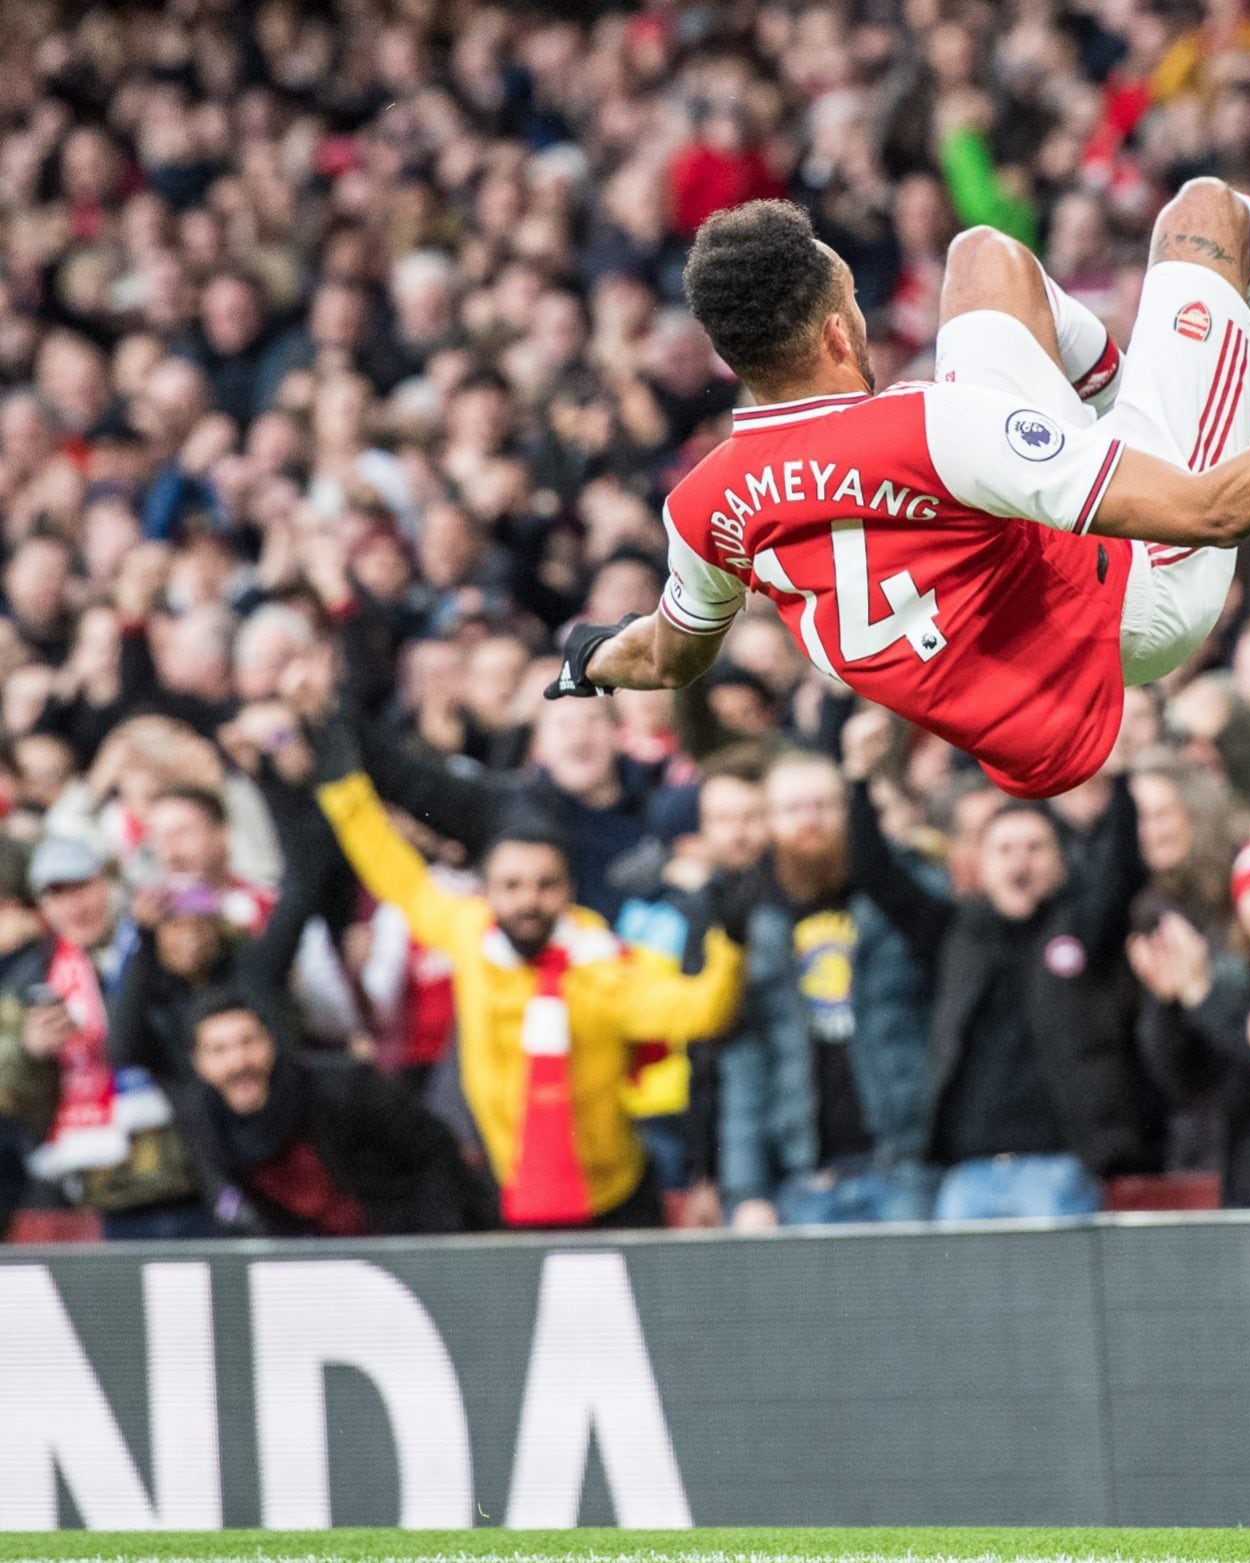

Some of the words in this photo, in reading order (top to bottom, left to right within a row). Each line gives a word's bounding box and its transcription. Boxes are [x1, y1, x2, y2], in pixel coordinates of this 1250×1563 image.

[711, 459, 940, 570] AUBAMEYANG
[753, 518, 948, 689] 14
[0, 1253, 694, 1530] NDA
